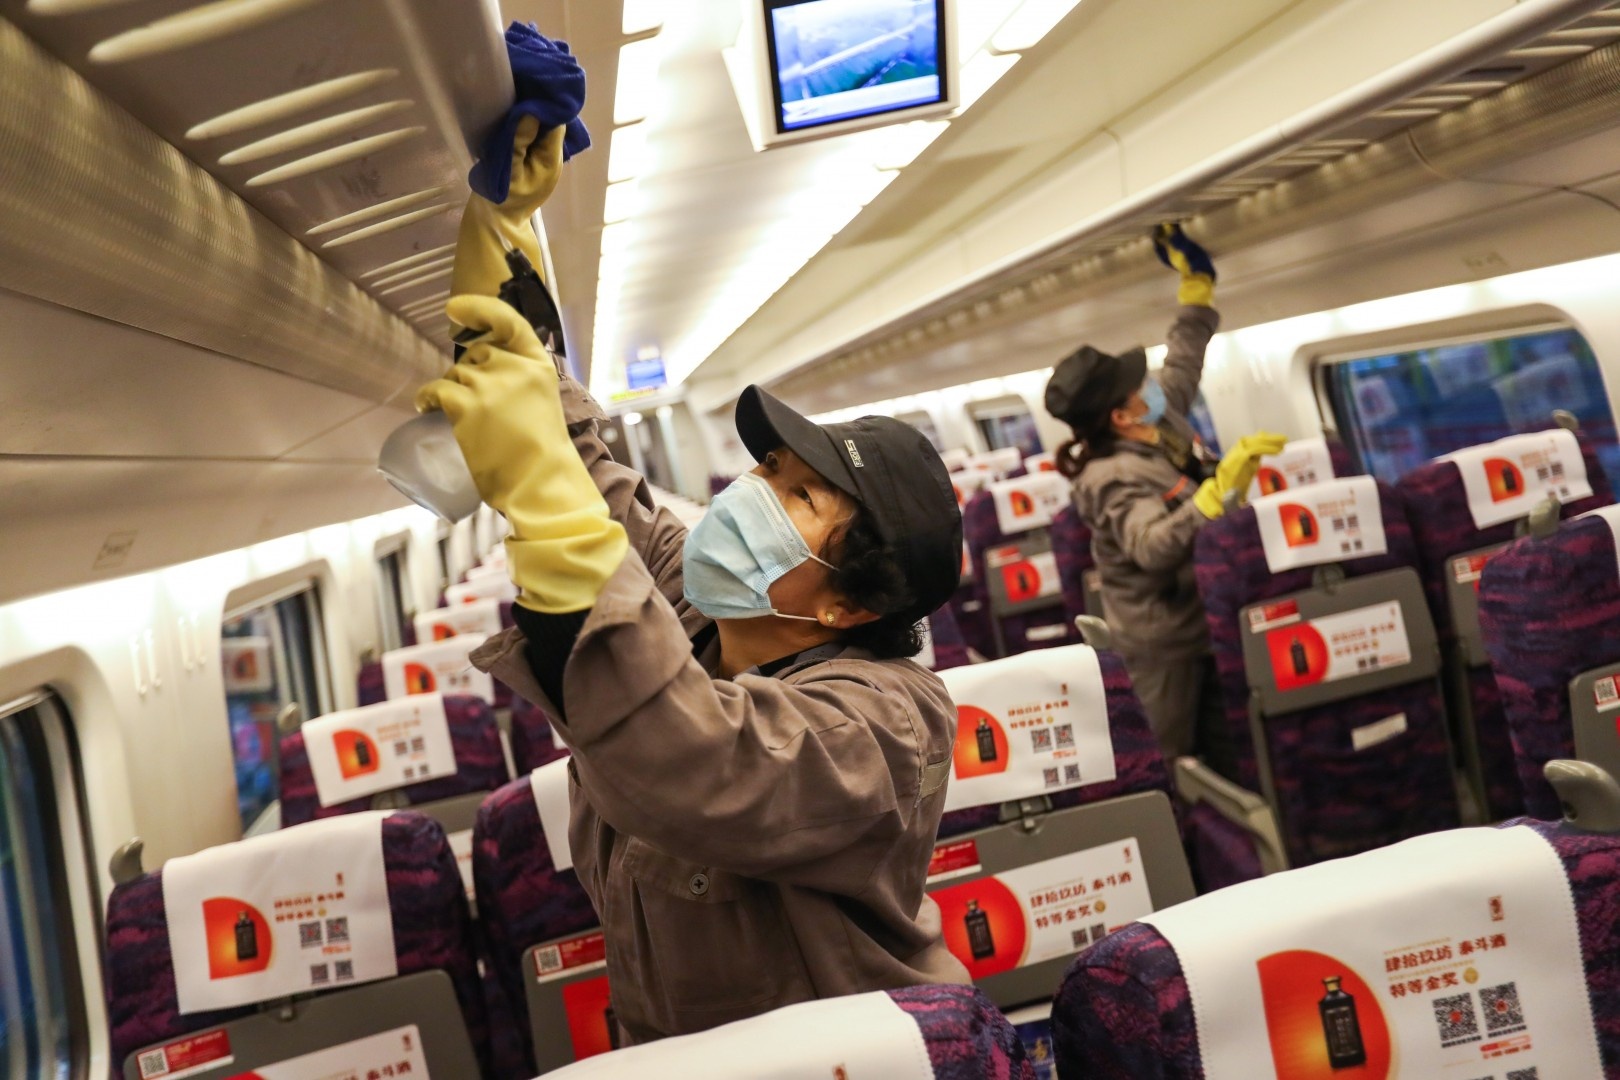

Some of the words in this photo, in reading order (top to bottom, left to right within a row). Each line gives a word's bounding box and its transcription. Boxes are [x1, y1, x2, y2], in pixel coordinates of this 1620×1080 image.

[1385, 945, 1452, 972] 肆拾玖坊
[1459, 933, 1507, 955] 泰斗酒
[1389, 972, 1459, 998] 特等金奖
